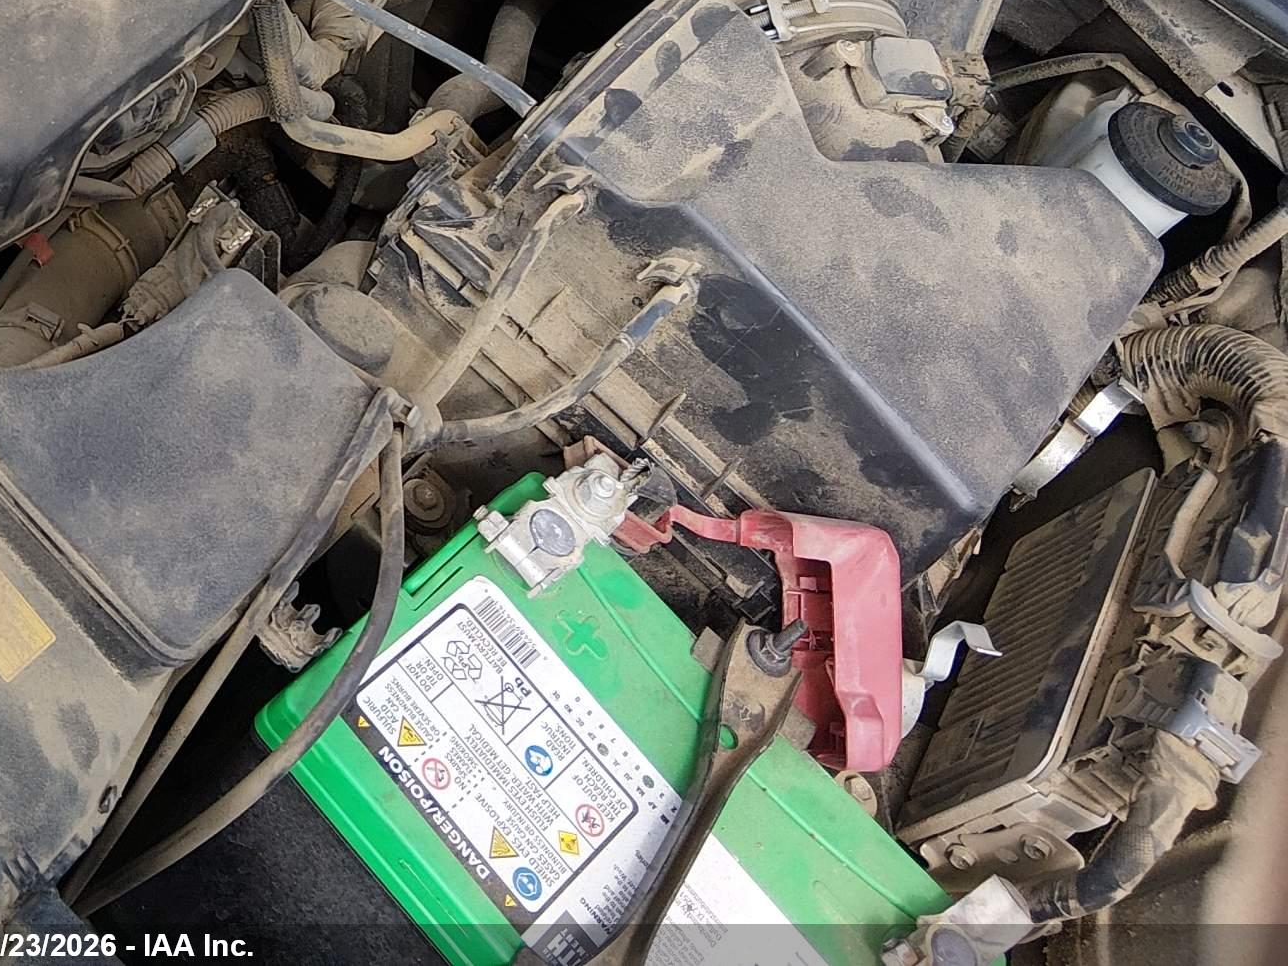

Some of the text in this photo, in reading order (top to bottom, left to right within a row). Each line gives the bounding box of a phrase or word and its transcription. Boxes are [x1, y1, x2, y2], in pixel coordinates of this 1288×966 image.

[456, 621, 503, 674] BATTERY MUST
[466, 617, 507, 667] BE RECYCLED.
[415, 660, 437, 686] TIP OR
[457, 655, 469, 668] Pb
[405, 663, 431, 692] DO NOT
[514, 677, 531, 697] Pb
[362, 696, 396, 734] SULFURIC
[380, 704, 399, 723] ACID
[384, 683, 433, 741] CAUSE BLINDNESS
[385, 696, 399, 712] CAN
[409, 700, 431, 725] SEVERE
[429, 724, 440, 736] OR
[468, 723, 499, 760] MEDICAL
[449, 735, 478, 769] SMOKING
[449, 746, 472, 774] FLAMES
[545, 739, 565, 761] READ
[444, 752, 467, 779] SPARKS
[496, 759, 511, 774] GET
[454, 776, 467, 790] NO
[464, 734, 548, 831] FLUSH EYES IMMEDIATELY
[582, 756, 627, 810] OF CHILDREN.
[583, 773, 621, 817] THE REACH
[524, 776, 560, 819] HELP FAST.
[572, 774, 615, 822] KEEP OUT OF
[647, 801, 657, 809] AP
[378, 746, 490, 879] DANGER/POISON
[474, 792, 512, 836] EXPLOSIVE
[531, 802, 554, 826] WITH
[524, 823, 534, 835] OR
[505, 815, 560, 880] GASES CAN CAUSE
[533, 835, 567, 874] BLINDNESS
[528, 857, 555, 887] SHIELD
